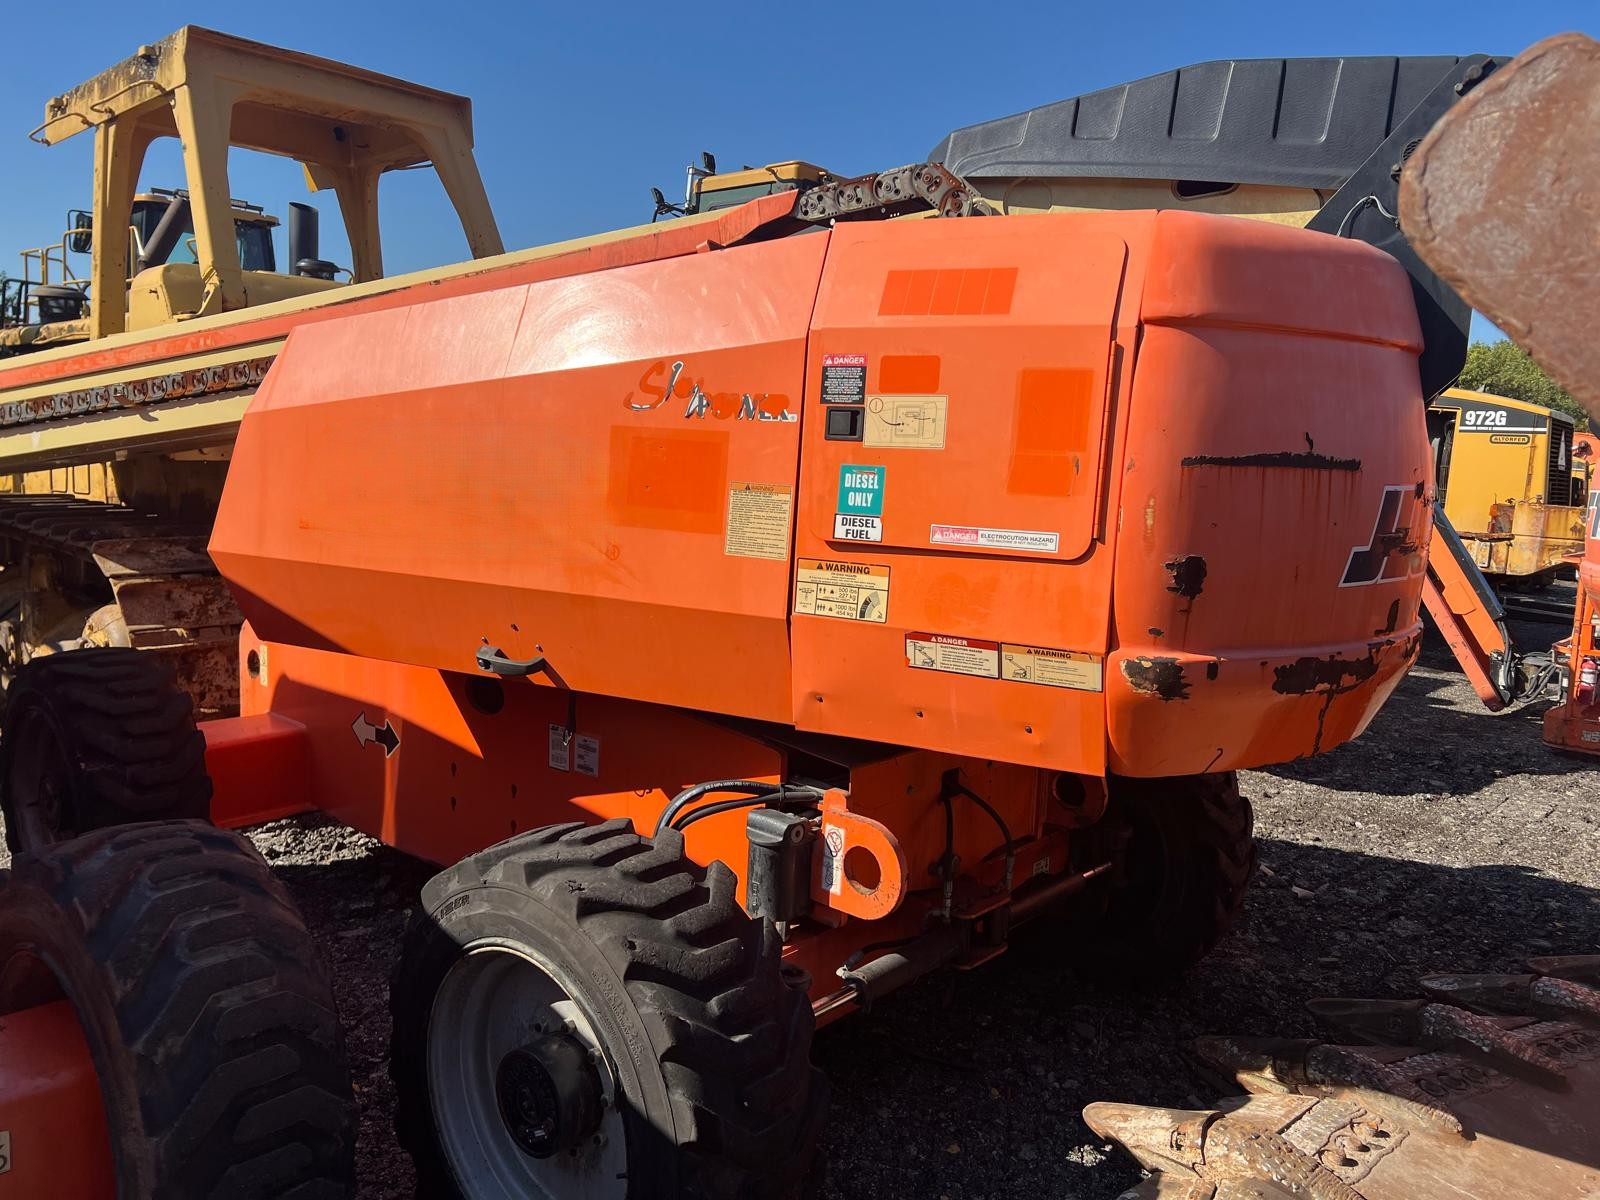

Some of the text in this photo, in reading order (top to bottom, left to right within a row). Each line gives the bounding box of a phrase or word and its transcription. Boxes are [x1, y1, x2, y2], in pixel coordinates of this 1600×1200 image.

[833, 356, 865, 365] DANGER
[1465, 410, 1507, 426] 972G
[844, 472, 879, 489] DIESEL
[847, 491, 873, 507] ONLY
[841, 516, 877, 529] DIESEL
[845, 528, 871, 540] FUEL
[980, 532, 1055, 544] ELECTROCUTION HAZARD
[825, 562, 871, 575] WARNING
[937, 636, 968, 647] DANGER
[1033, 648, 1072, 660] WARNING
